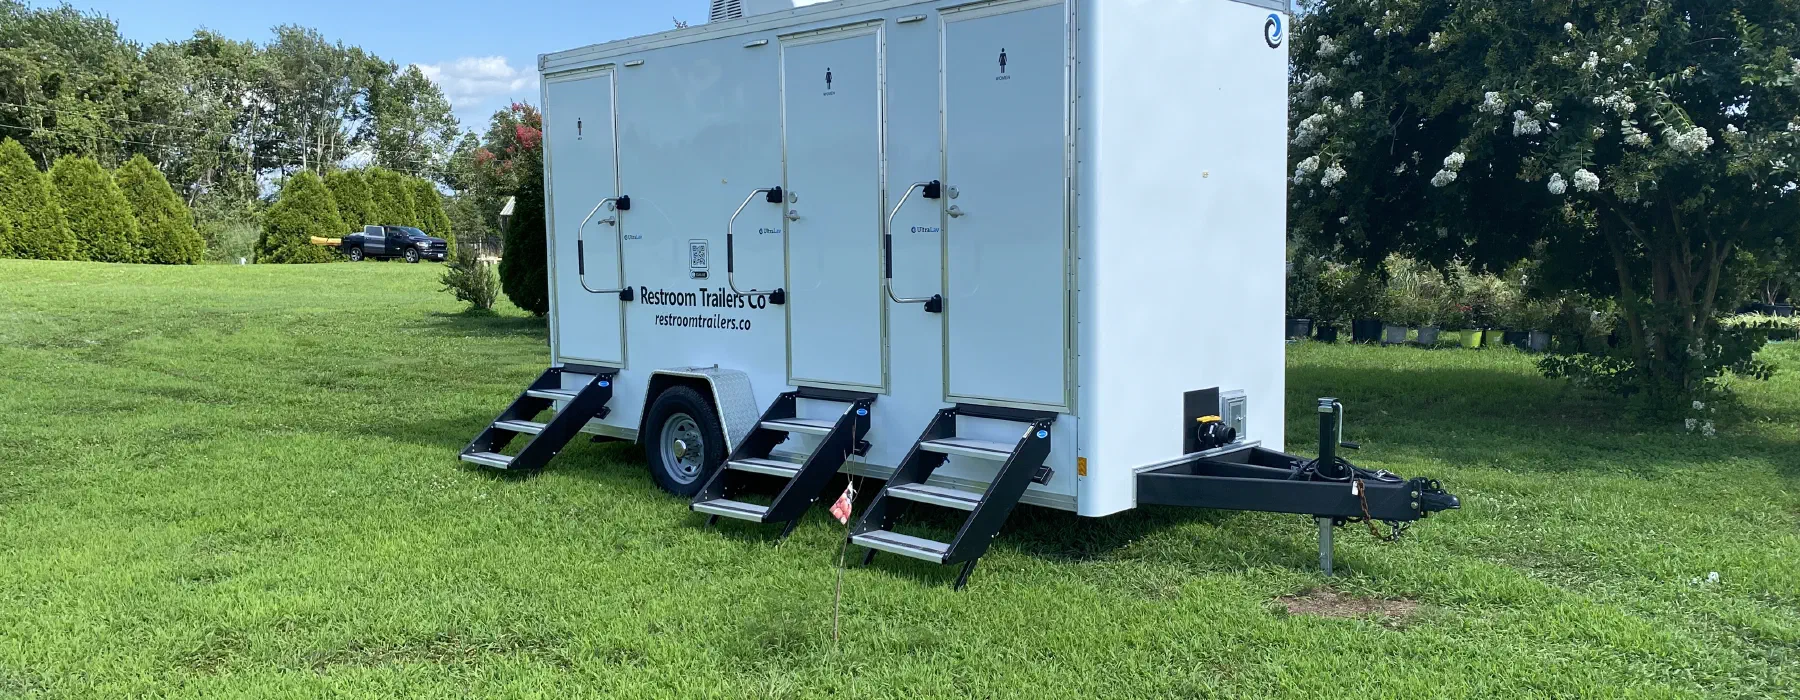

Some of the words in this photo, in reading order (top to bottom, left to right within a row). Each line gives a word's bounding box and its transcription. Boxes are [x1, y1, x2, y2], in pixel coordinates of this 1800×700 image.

[640, 286, 697, 307] Restroom
[699, 287, 745, 309] Trailers
[748, 289, 766, 310] Co
[655, 313, 751, 331] restroomtrailers.co
